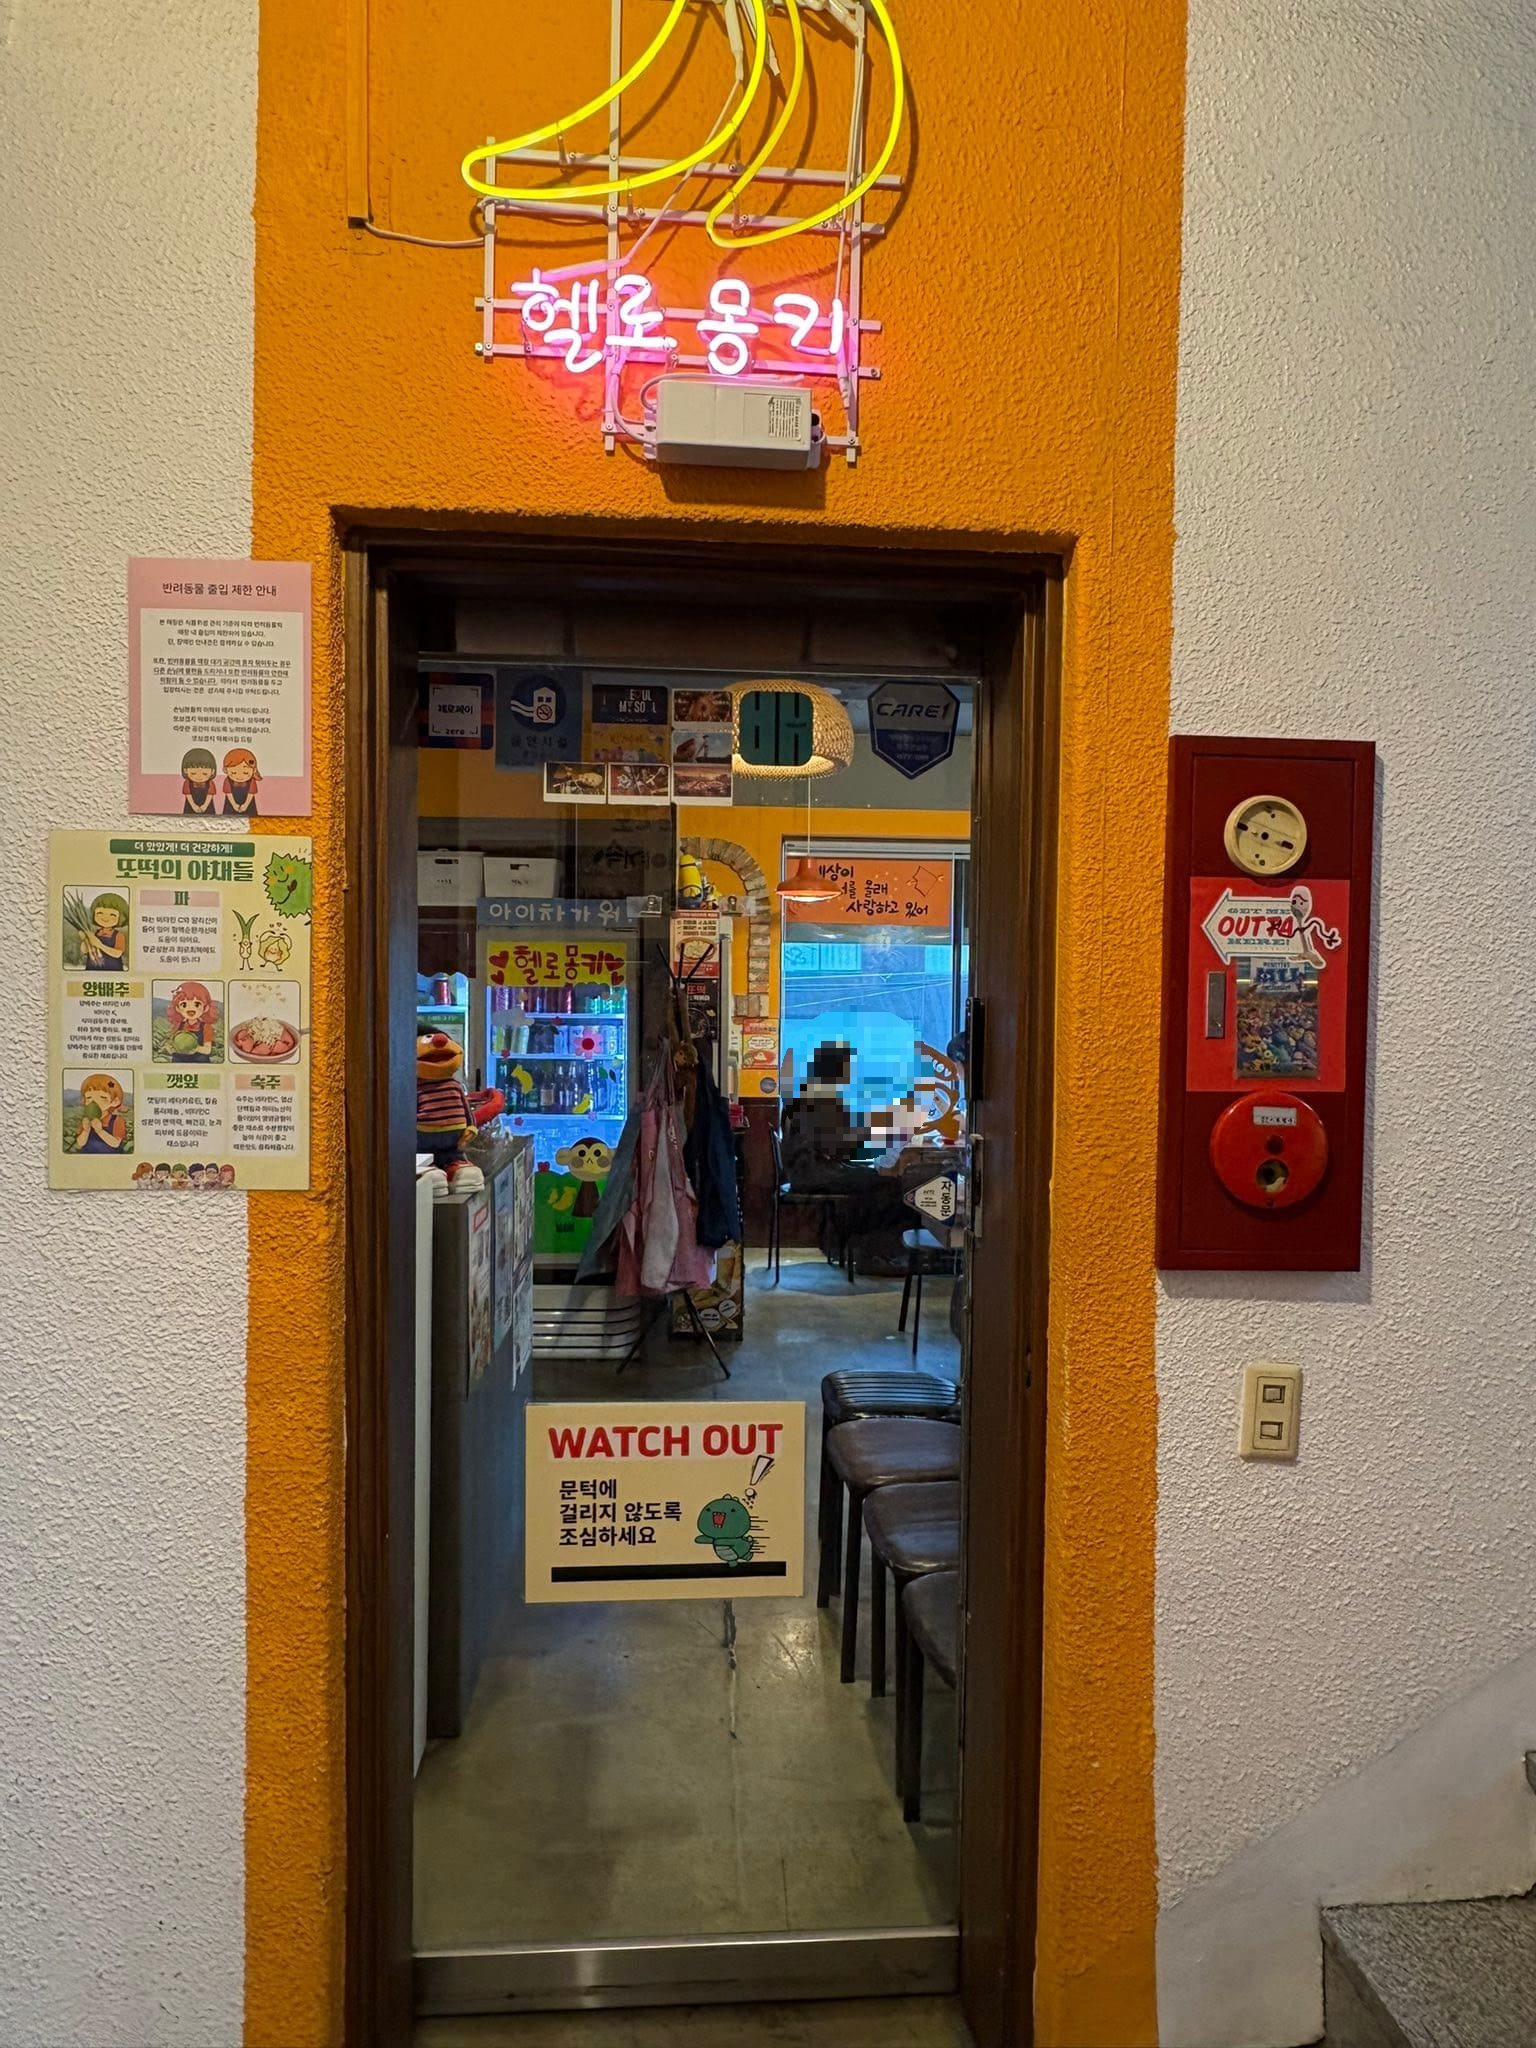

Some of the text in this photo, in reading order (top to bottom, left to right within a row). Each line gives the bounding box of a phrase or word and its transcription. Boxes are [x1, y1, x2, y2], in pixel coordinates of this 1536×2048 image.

[511, 268, 843, 375] 헬로 몽키
[162, 583, 277, 597] 반려동물 출입 제한 안내
[116, 859, 254, 881] 또떡의 야채들
[846, 899, 928, 918] 사랑하고 있어
[82, 982, 130, 997] 양배추
[166, 1074, 199, 1088] 깻잎
[940, 1180, 952, 1217] 자동문
[548, 1424, 784, 1459] WATCH OUT
[559, 1479, 617, 1500] 문턱에
[559, 1502, 682, 1524] 걸리지 않도록
[559, 1526, 657, 1547] 조심하세요
